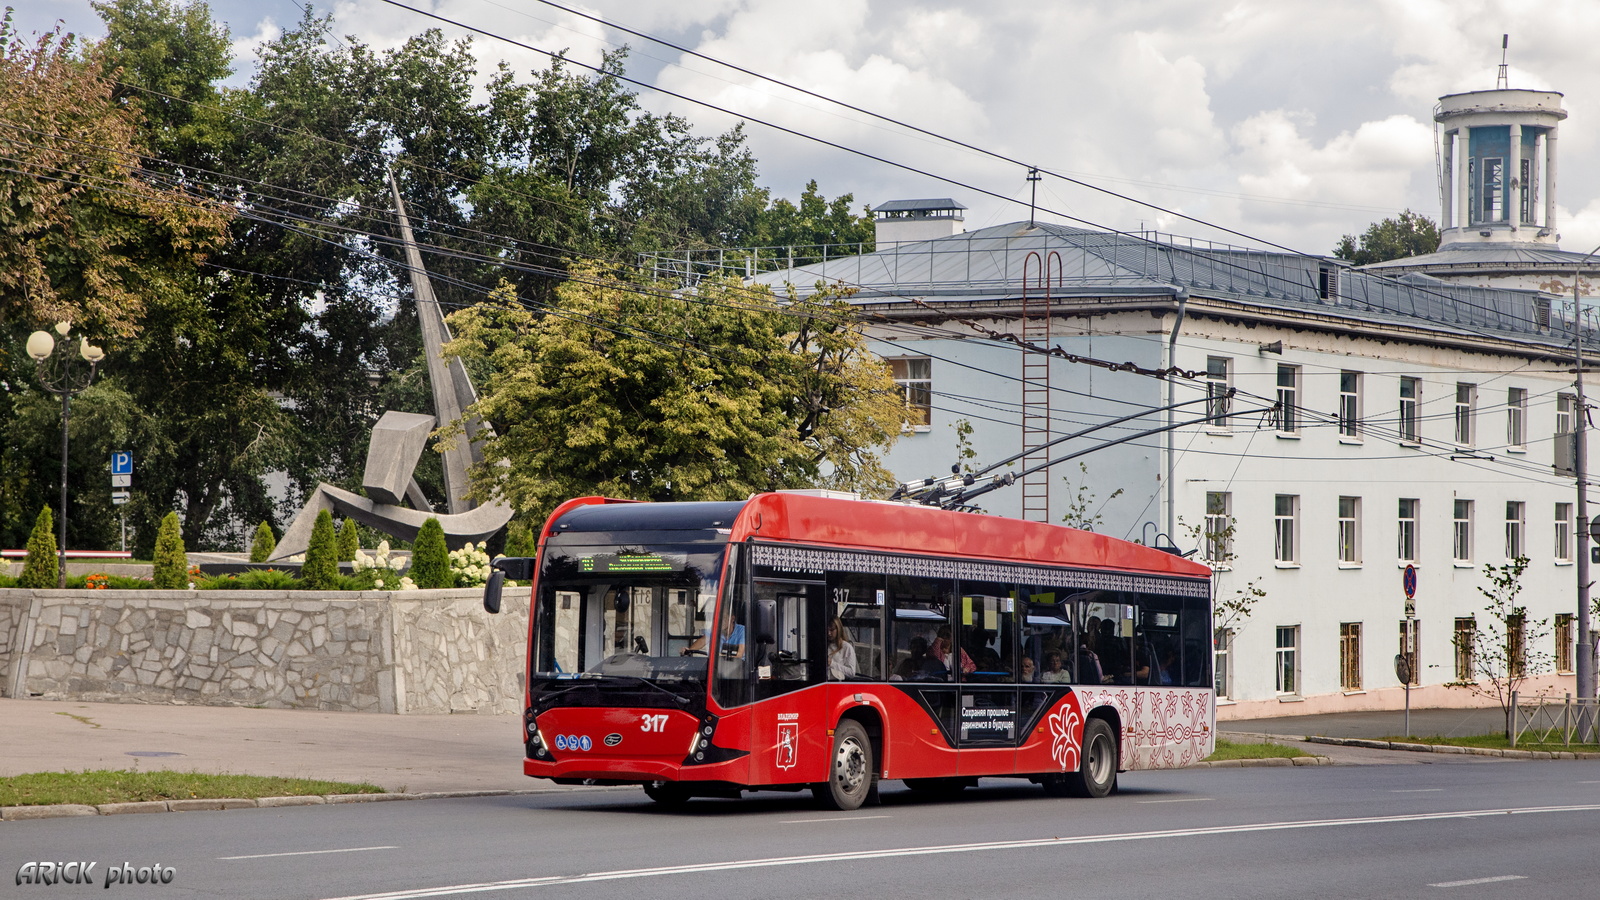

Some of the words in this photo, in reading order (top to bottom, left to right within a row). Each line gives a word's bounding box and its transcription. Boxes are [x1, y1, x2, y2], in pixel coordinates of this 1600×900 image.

[117, 453, 128, 472] P
[833, 587, 850, 604] 317
[961, 707, 986, 719] Сохраняя
[987, 709, 1009, 719] прошлое
[640, 713, 669, 732] 317
[961, 721, 987, 731] движемся
[988, 721, 992, 729] в
[993, 718, 1014, 731] будущее
